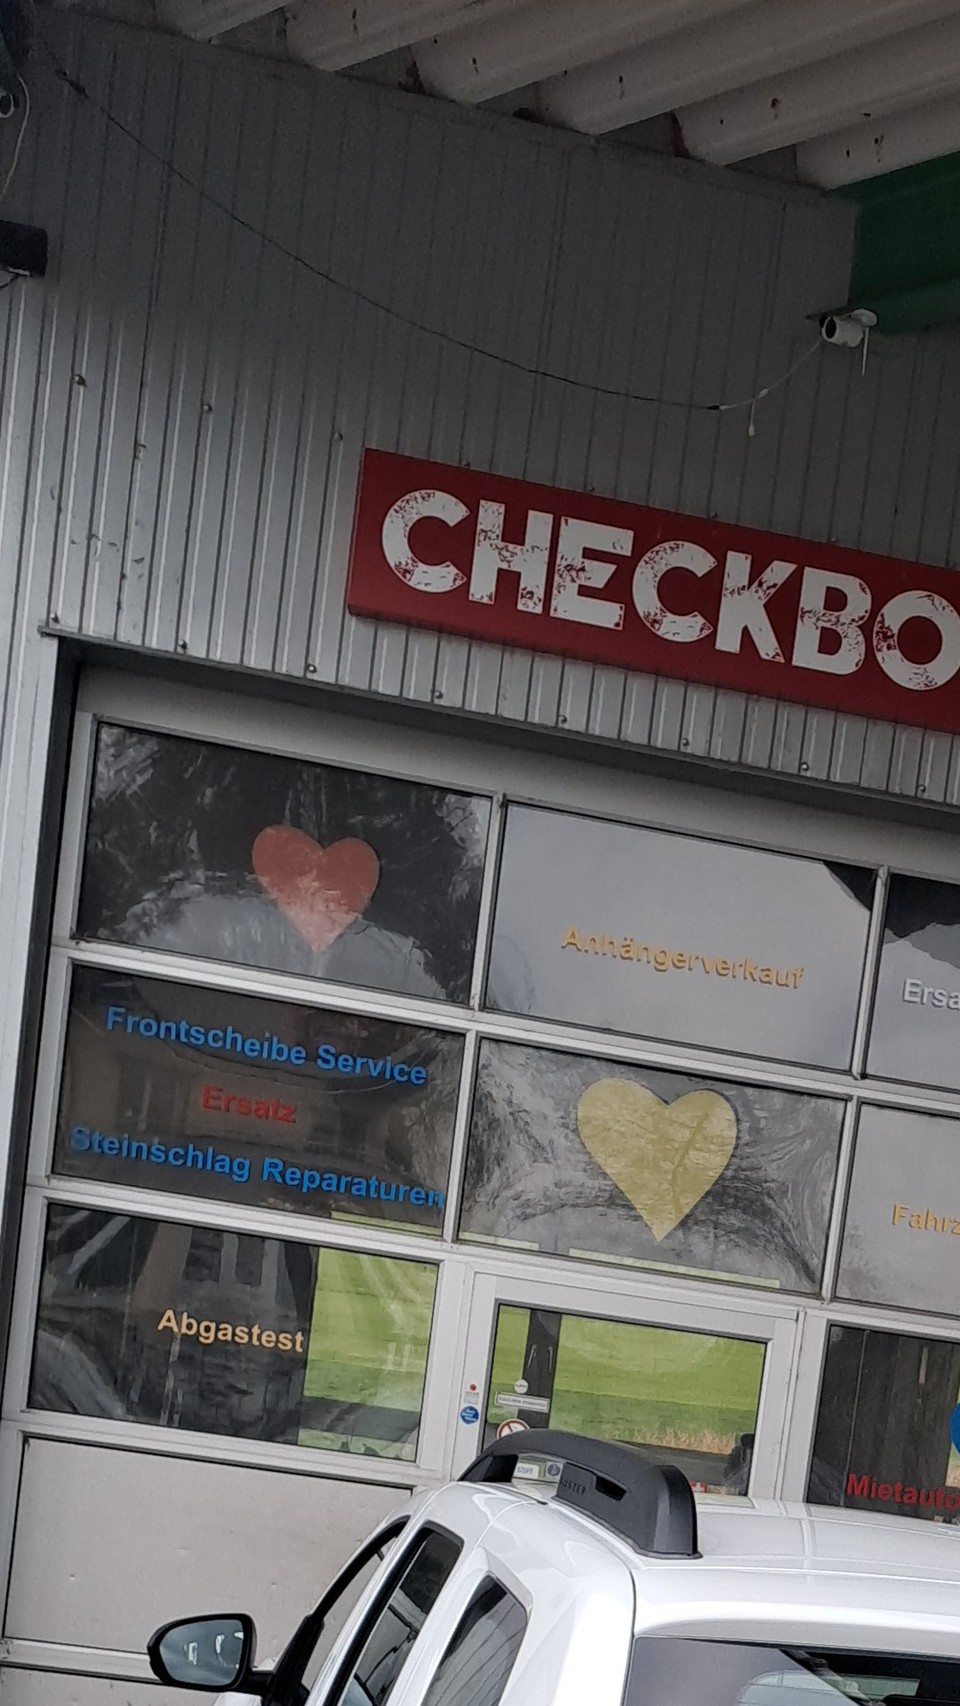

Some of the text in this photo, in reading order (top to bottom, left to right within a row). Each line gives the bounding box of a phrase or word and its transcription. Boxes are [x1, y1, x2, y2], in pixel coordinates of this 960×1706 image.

[561, 925, 804, 989] Anhängerverkauf
[106, 1006, 428, 1086] Frontscheibe Service
[200, 1083, 298, 1124] Ersatz
[70, 1126, 444, 1209] Steinschlag Reparaturen
[157, 1308, 304, 1352] Abgastest
